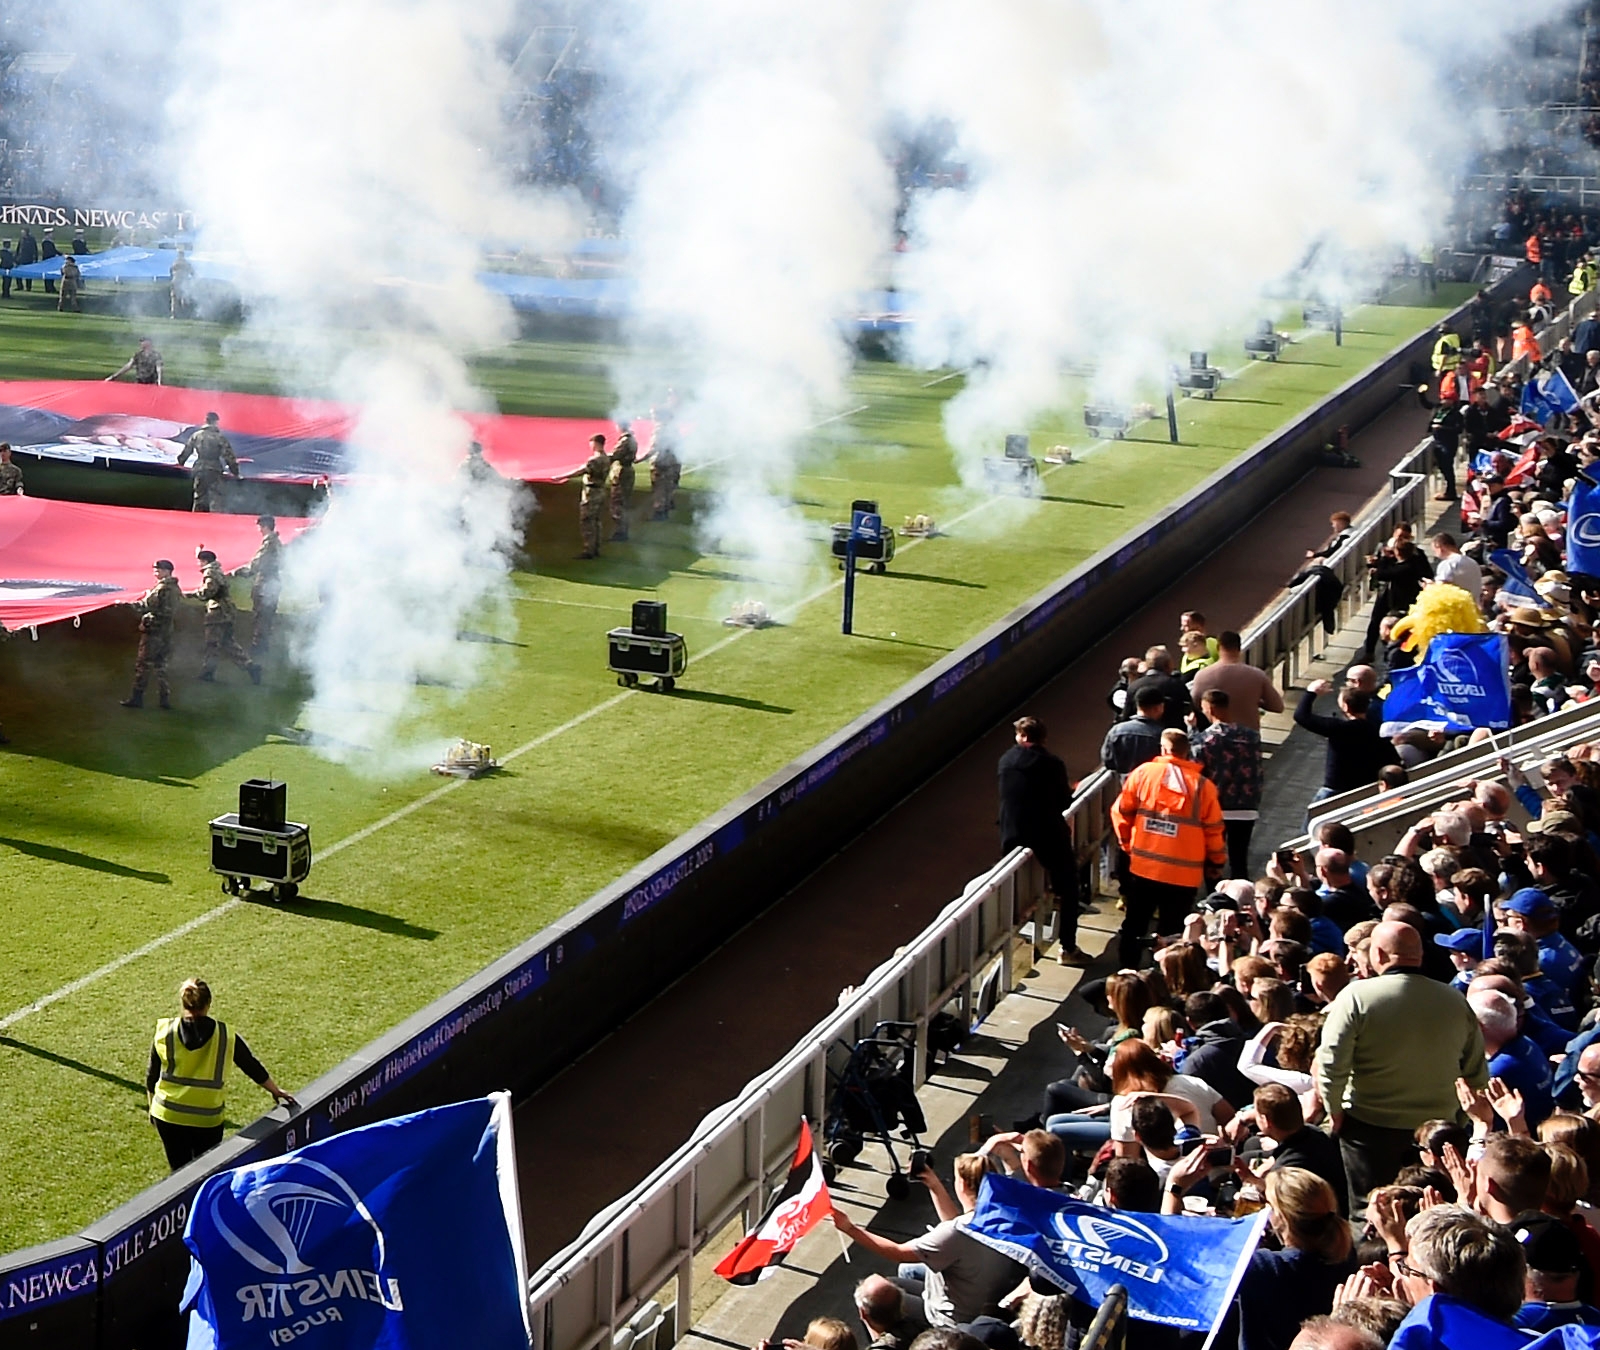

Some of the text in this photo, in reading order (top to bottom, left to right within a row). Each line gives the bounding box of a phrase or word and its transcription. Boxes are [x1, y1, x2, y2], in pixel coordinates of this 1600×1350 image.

[328, 1086, 358, 1123] Share
[359, 1071, 382, 1107] your
[504, 968, 533, 1001] Stories
[7, 1230, 145, 1309] NEWCASTLE
[147, 1202, 188, 1251] 2019
